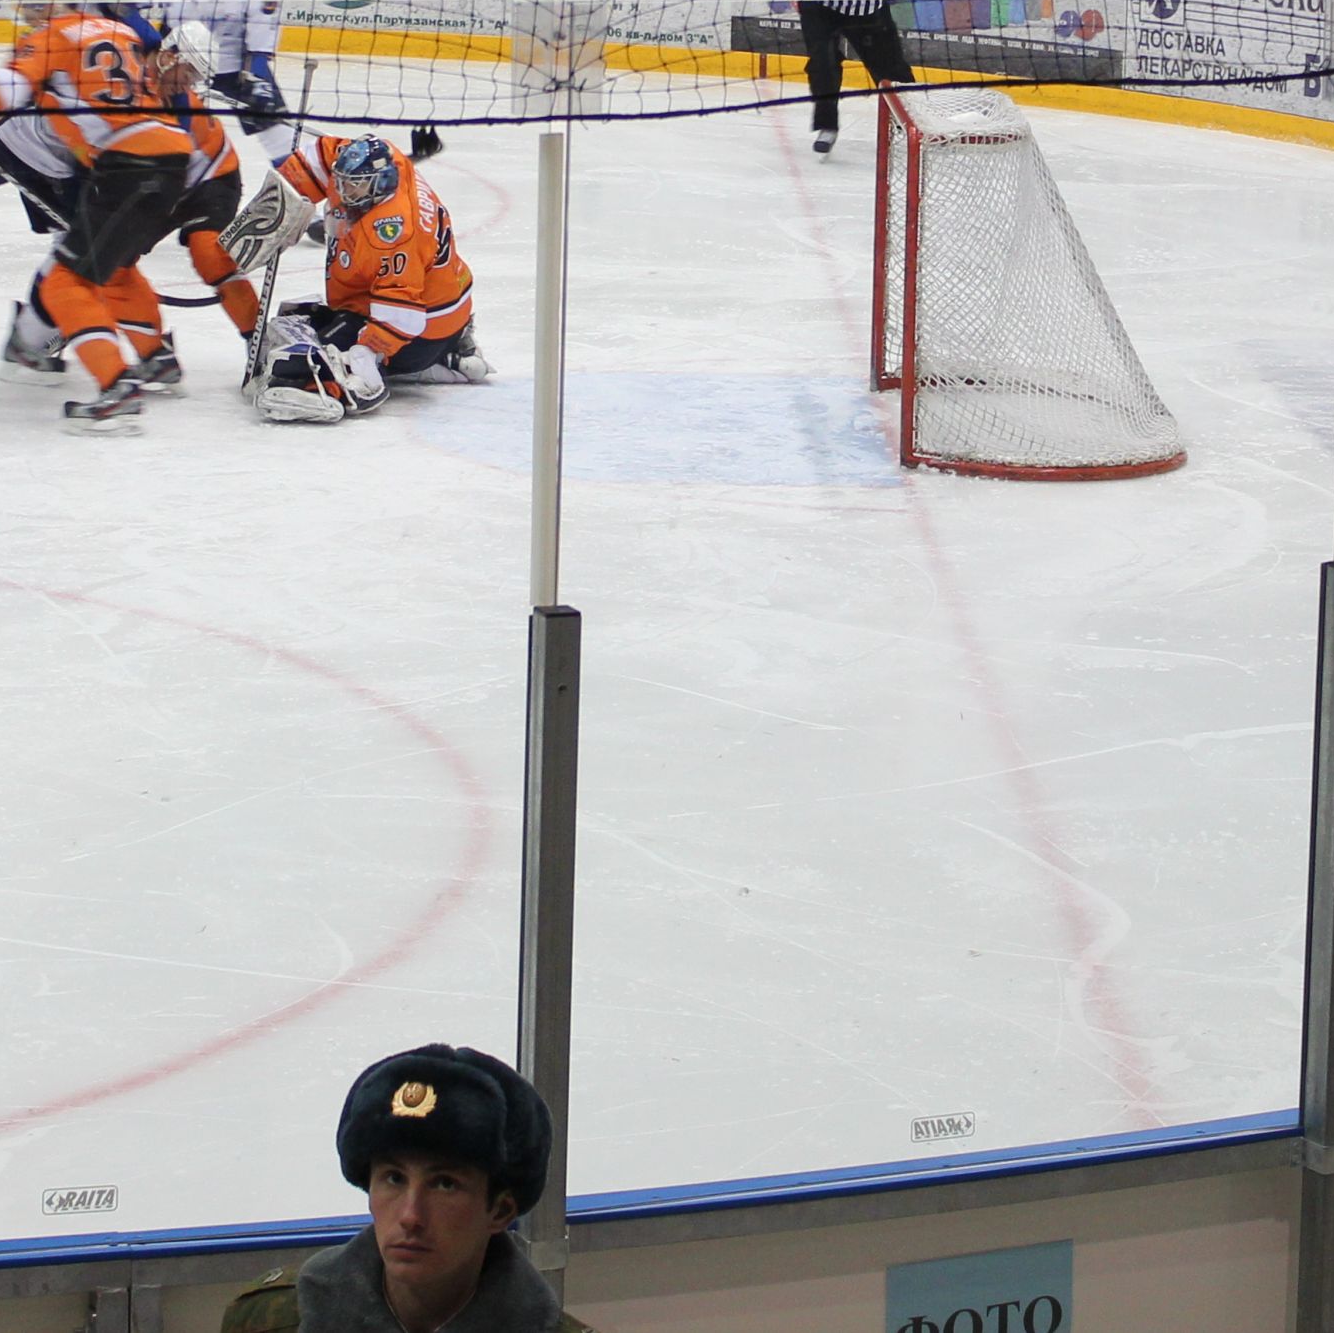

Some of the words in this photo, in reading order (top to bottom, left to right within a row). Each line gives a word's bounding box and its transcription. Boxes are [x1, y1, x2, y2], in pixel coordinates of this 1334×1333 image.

[470, 18, 484, 29] 71
[1138, 28, 1225, 57] ДОСТАВКА
[81, 40, 143, 107] 3
[218, 208, 252, 245] Reebok
[63, 1189, 116, 1209] RAITA
